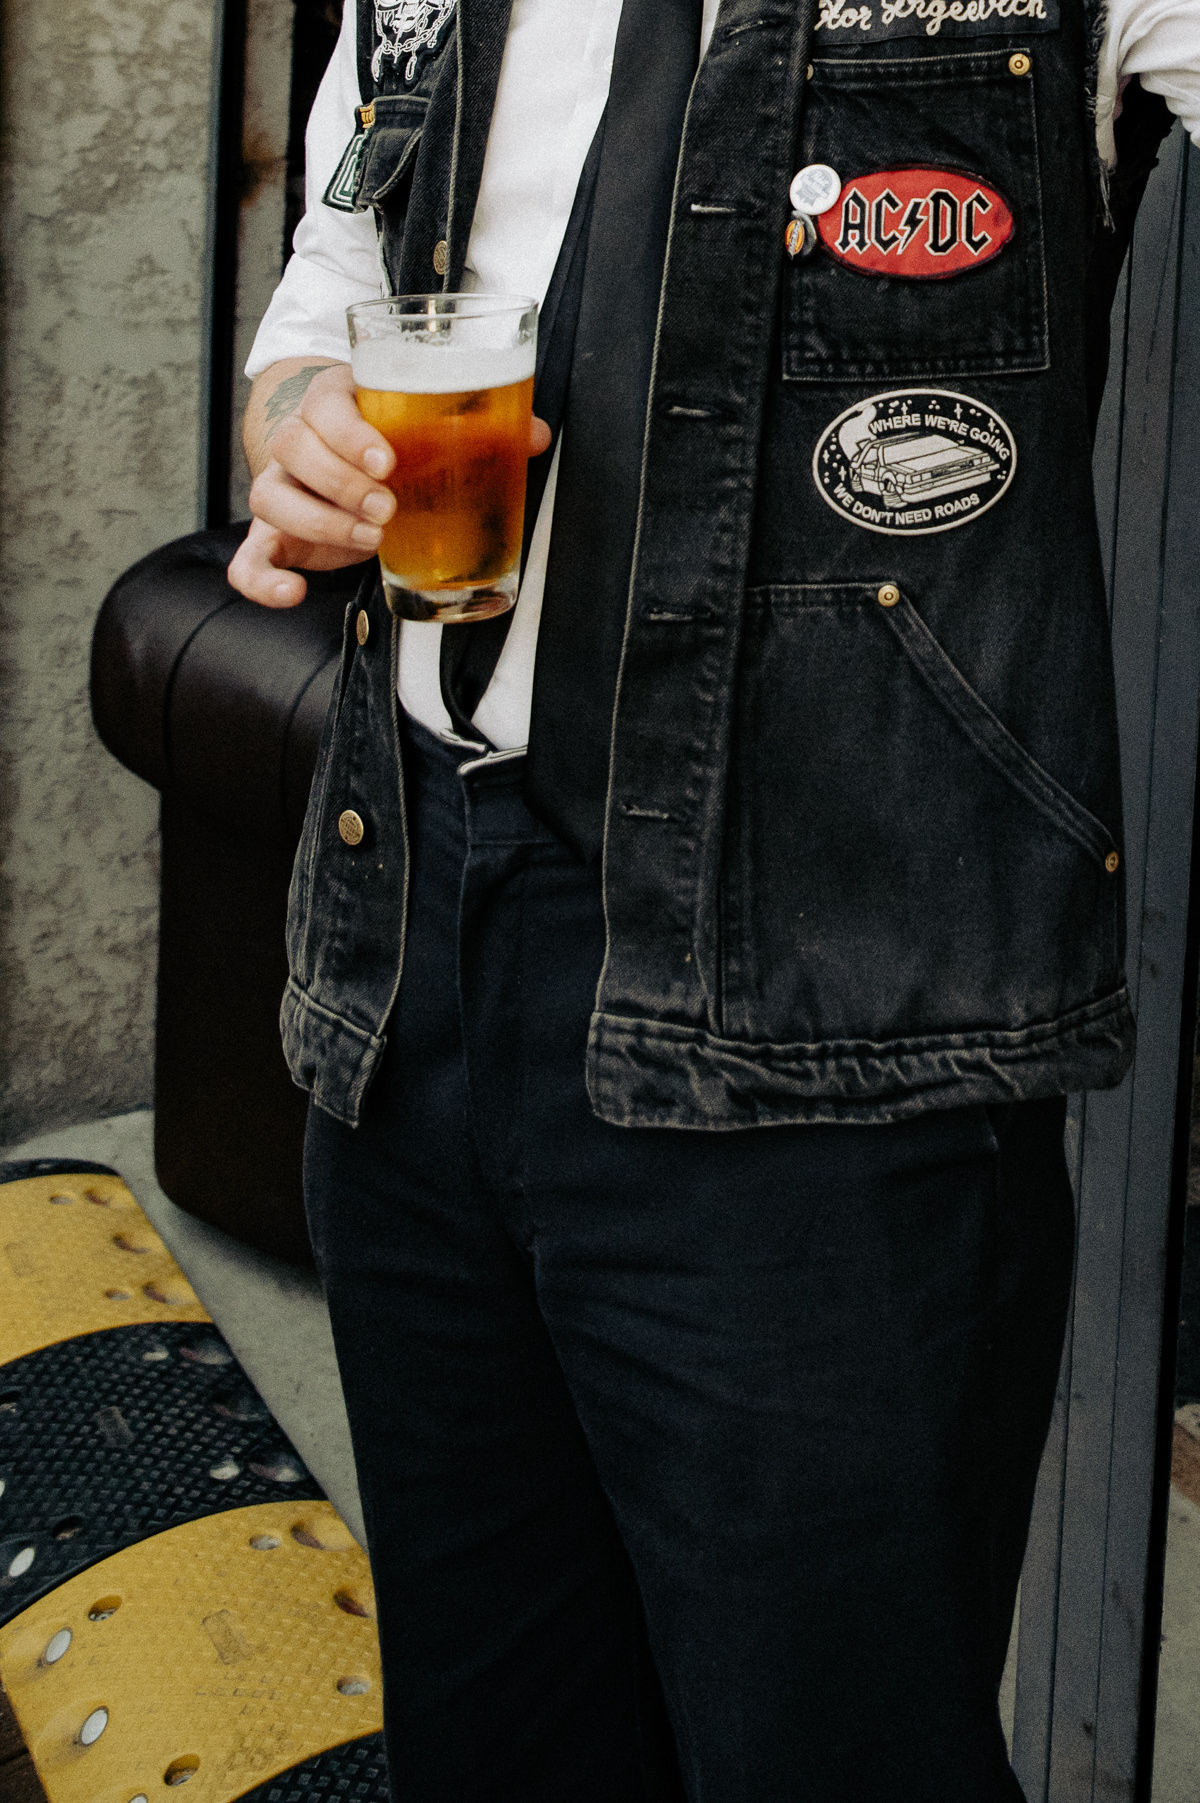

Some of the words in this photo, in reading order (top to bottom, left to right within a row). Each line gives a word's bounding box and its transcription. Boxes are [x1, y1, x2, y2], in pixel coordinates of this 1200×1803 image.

[869, 413, 921, 435] WHERE
[924, 413, 969, 436] WE'RE
[969, 427, 1010, 461] GOING
[833, 482, 855, 508] WE
[852, 500, 894, 525] DON'T
[894, 508, 933, 526] NEED
[934, 492, 981, 519] ROADS
